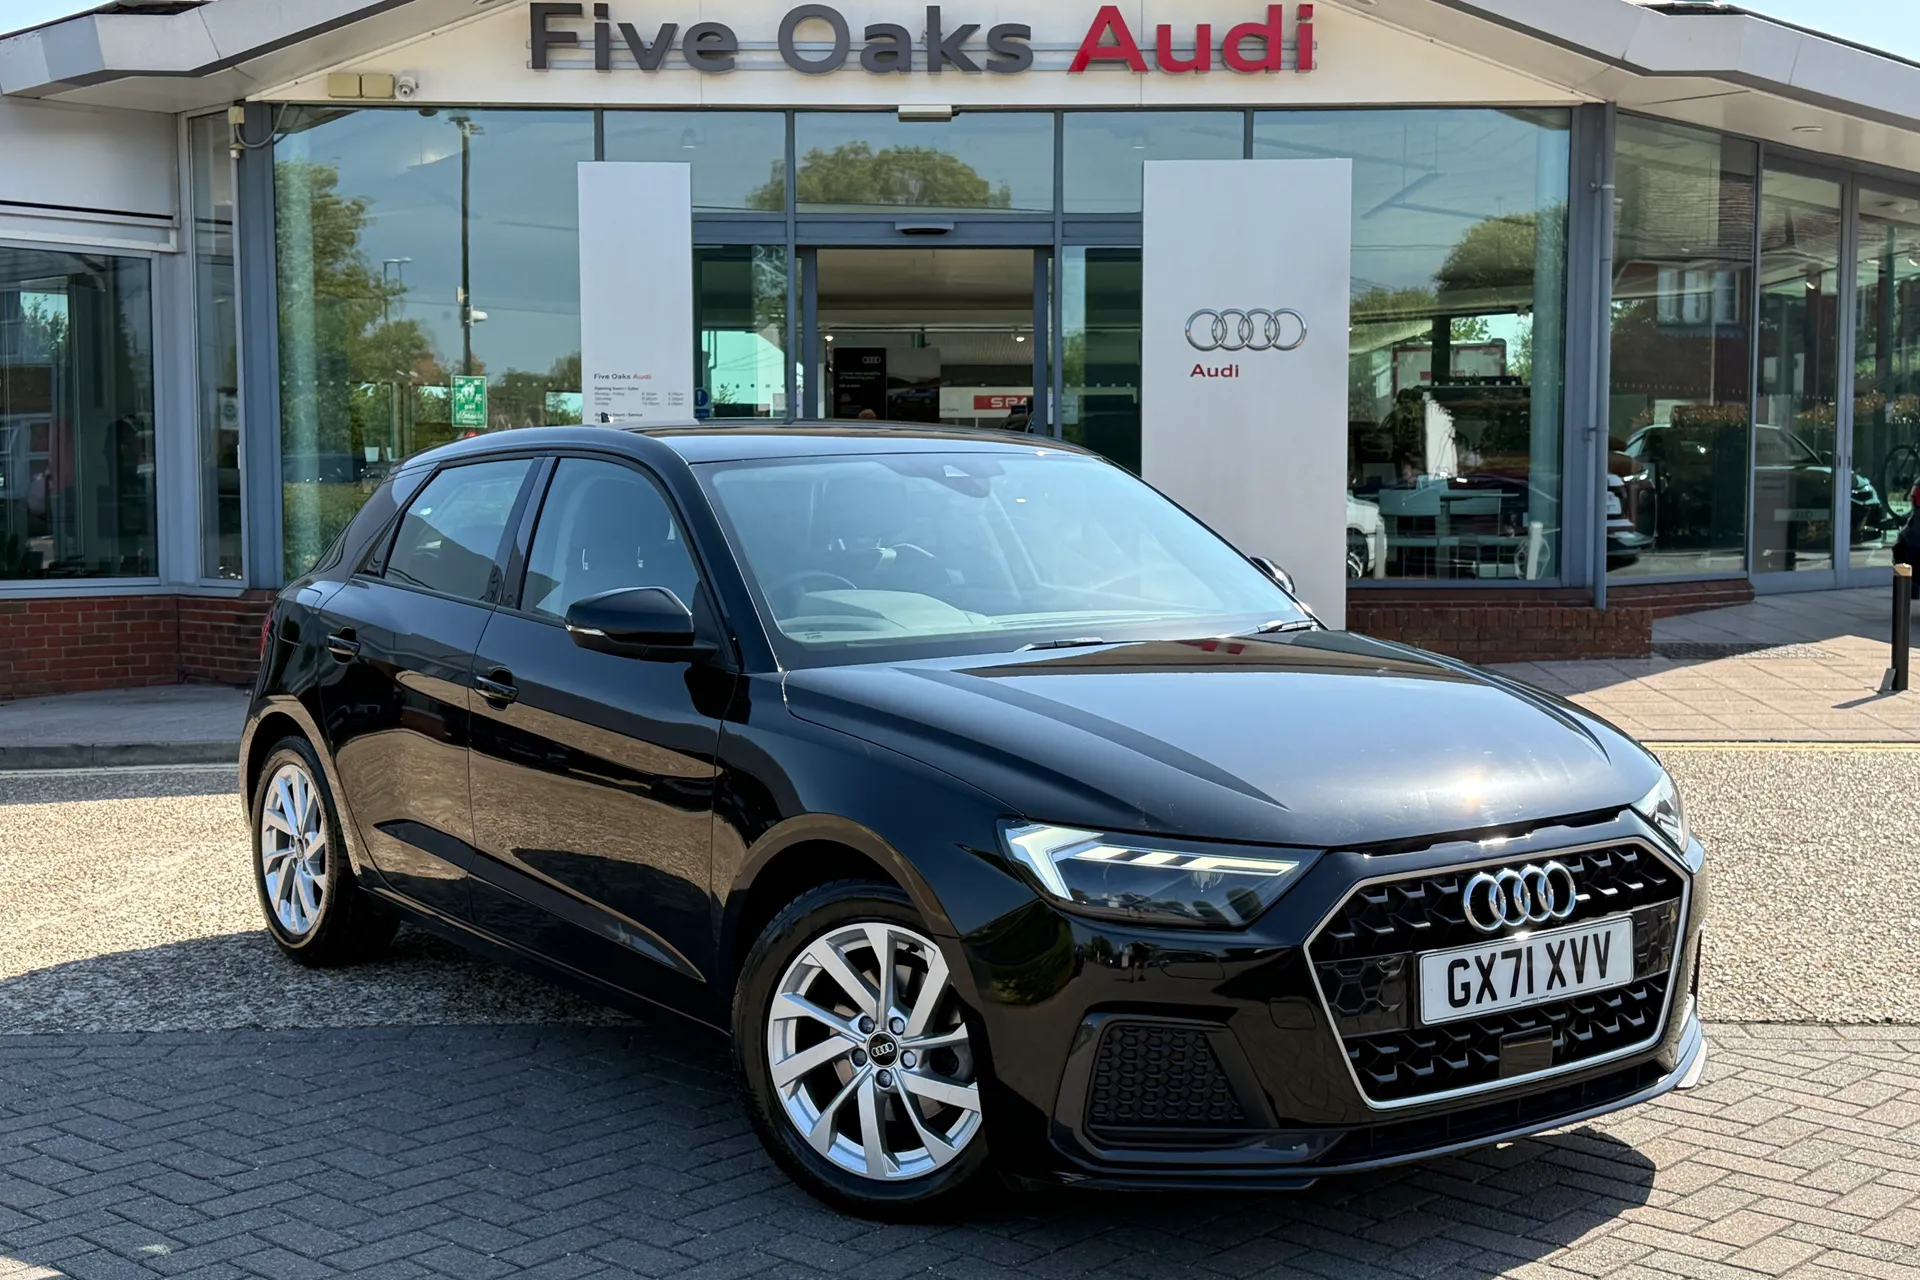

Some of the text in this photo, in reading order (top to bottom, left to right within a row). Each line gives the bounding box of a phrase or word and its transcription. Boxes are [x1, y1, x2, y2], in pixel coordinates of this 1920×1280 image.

[530, 2, 1314, 75] Five Oaks Audi
[1190, 363, 1239, 378] Audi
[1447, 930, 1611, 1009] GX71 XVV
